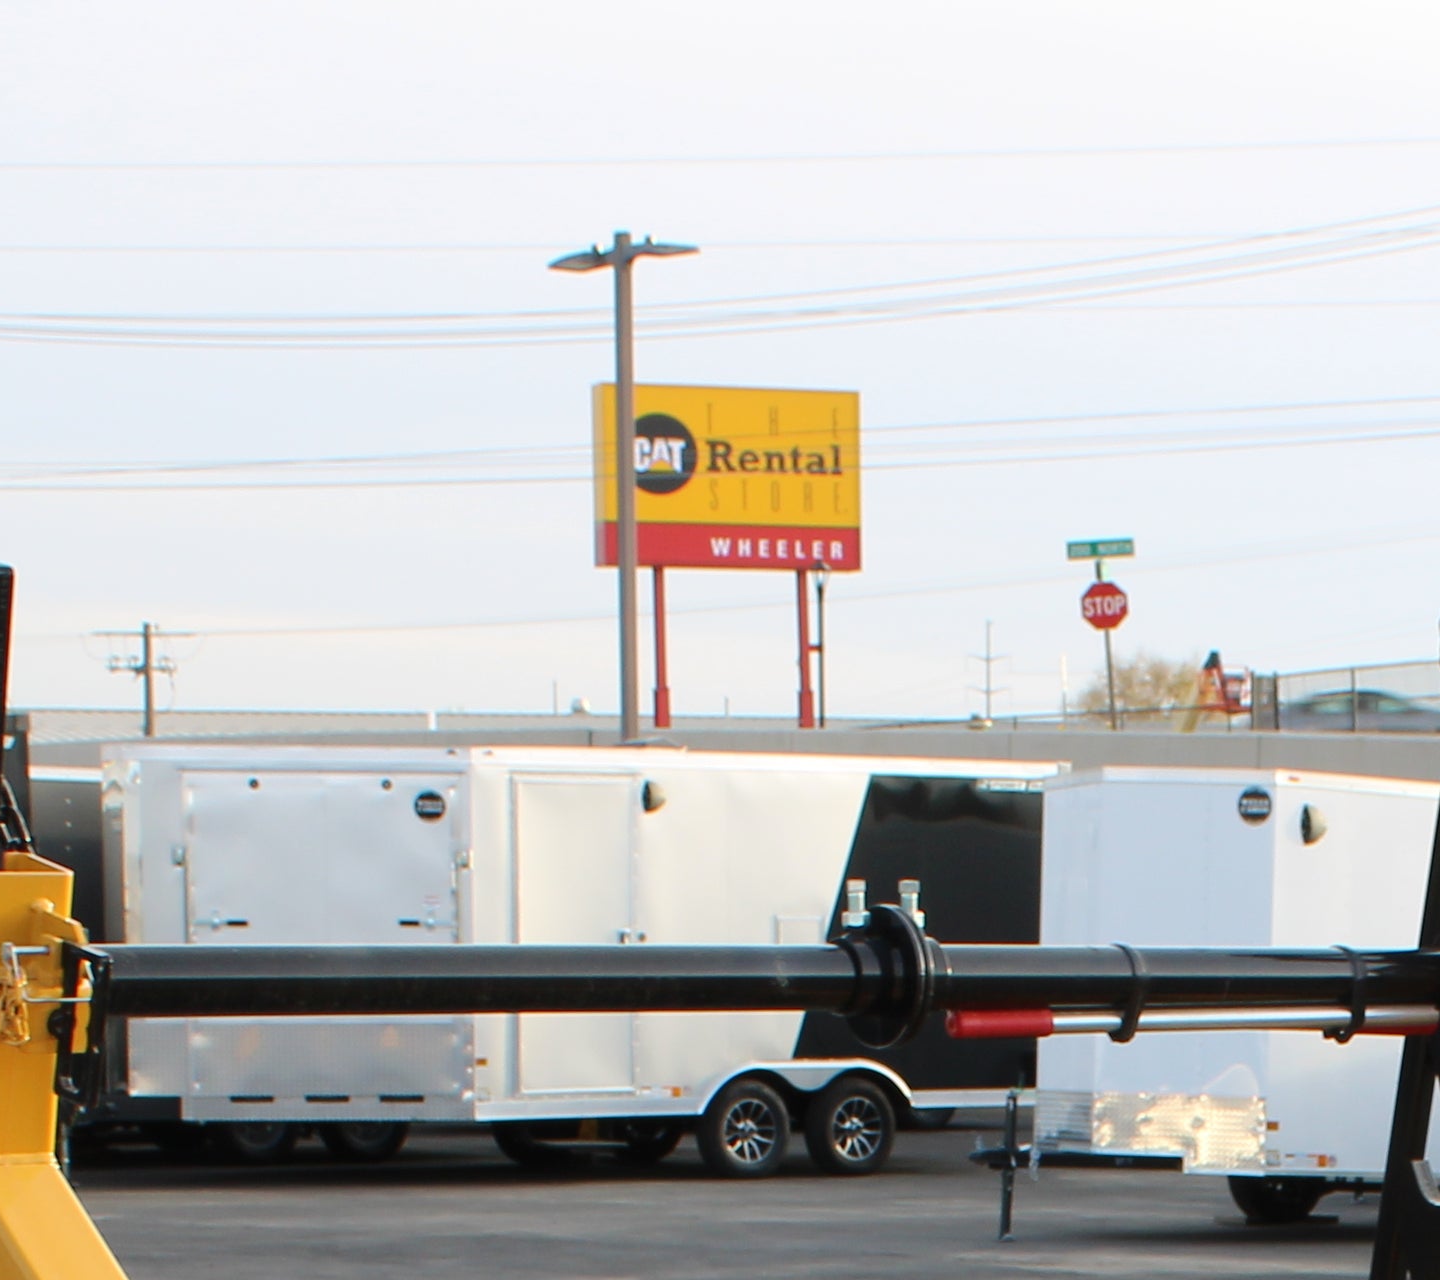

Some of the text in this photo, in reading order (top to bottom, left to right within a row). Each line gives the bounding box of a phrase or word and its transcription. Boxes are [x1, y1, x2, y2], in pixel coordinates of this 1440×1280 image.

[634, 436, 687, 474] CAT
[706, 439, 843, 476] Rental
[710, 537, 844, 560] WHEELER
[1083, 594, 1126, 618] STOP
